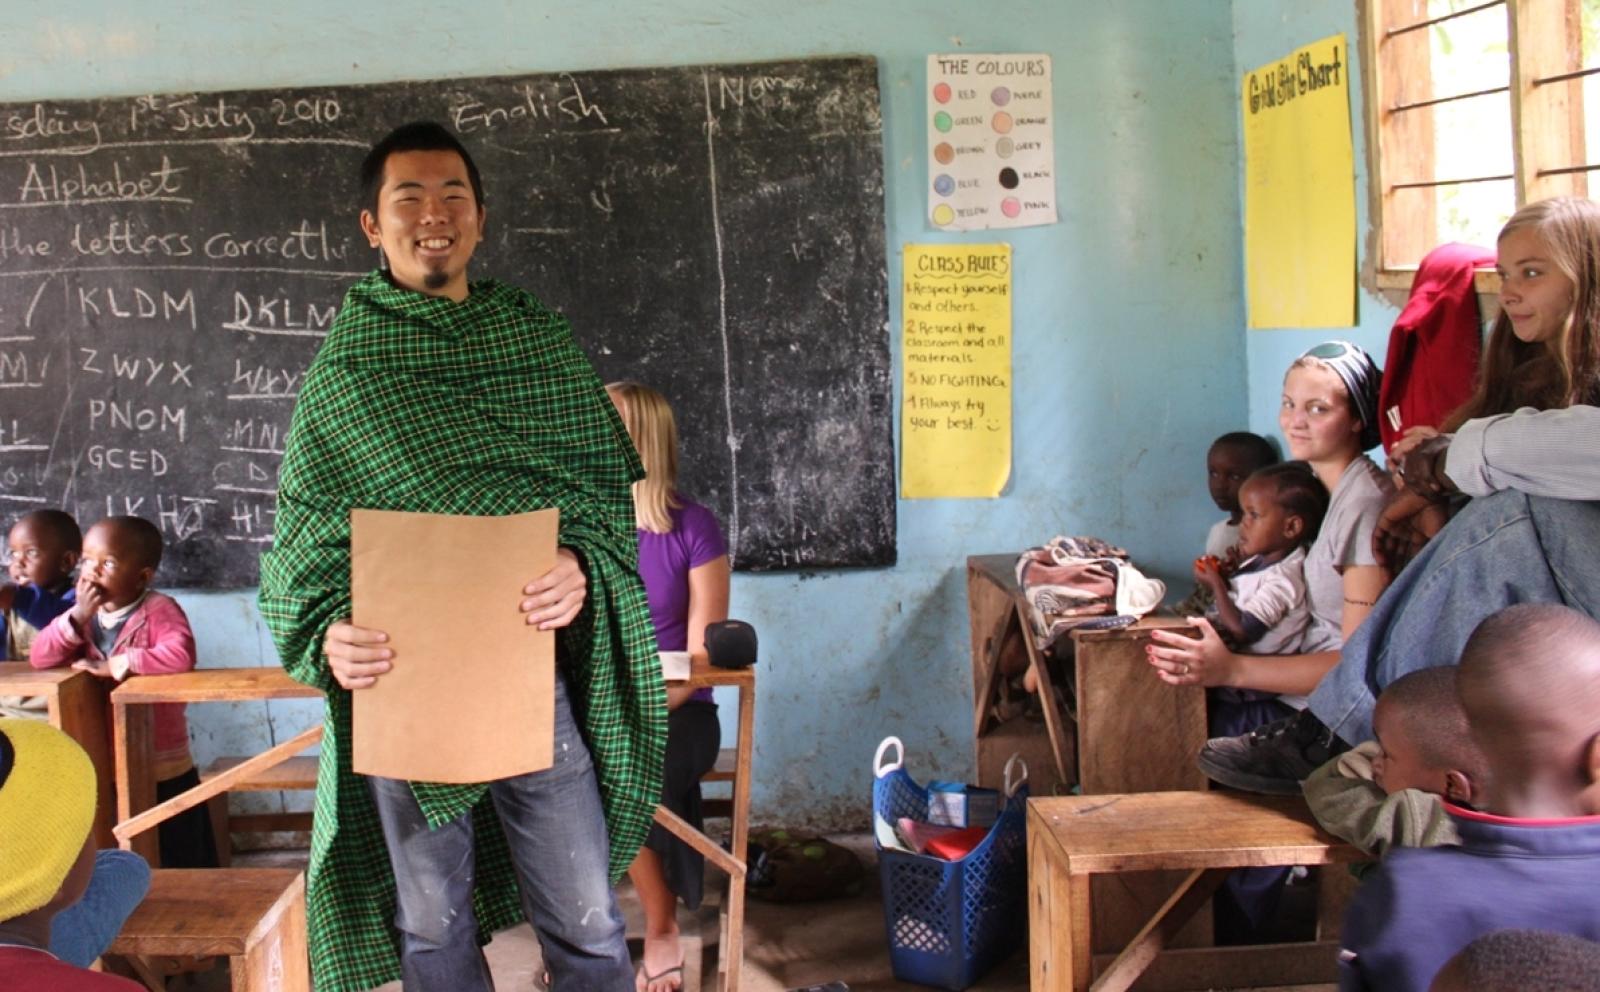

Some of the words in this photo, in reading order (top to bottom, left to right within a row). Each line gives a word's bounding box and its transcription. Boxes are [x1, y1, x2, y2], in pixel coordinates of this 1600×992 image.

[938, 59, 969, 75] THE
[976, 60, 1045, 76] COLOURS
[1297, 45, 1341, 95] Chart
[958, 90, 976, 99] RED
[272, 98, 341, 126] 2010
[955, 116, 983, 126] GREEN
[1015, 142, 1041, 151] GREY
[19, 155, 188, 206] Alphabet
[71, 219, 193, 256] letters
[918, 254, 964, 274] CLASS
[967, 254, 1009, 275] RULES
[914, 282, 958, 298] Respect
[961, 283, 1007, 298] yourself
[79, 287, 196, 330] KLDM
[909, 301, 932, 312] and
[919, 321, 963, 335] Respect
[963, 336, 984, 348] and
[987, 335, 1005, 347] all
[920, 374, 937, 386] NO
[966, 398, 985, 417] try
[90, 399, 186, 442] PNOM
[910, 416, 937, 432] your
[88, 445, 168, 476] GCED
